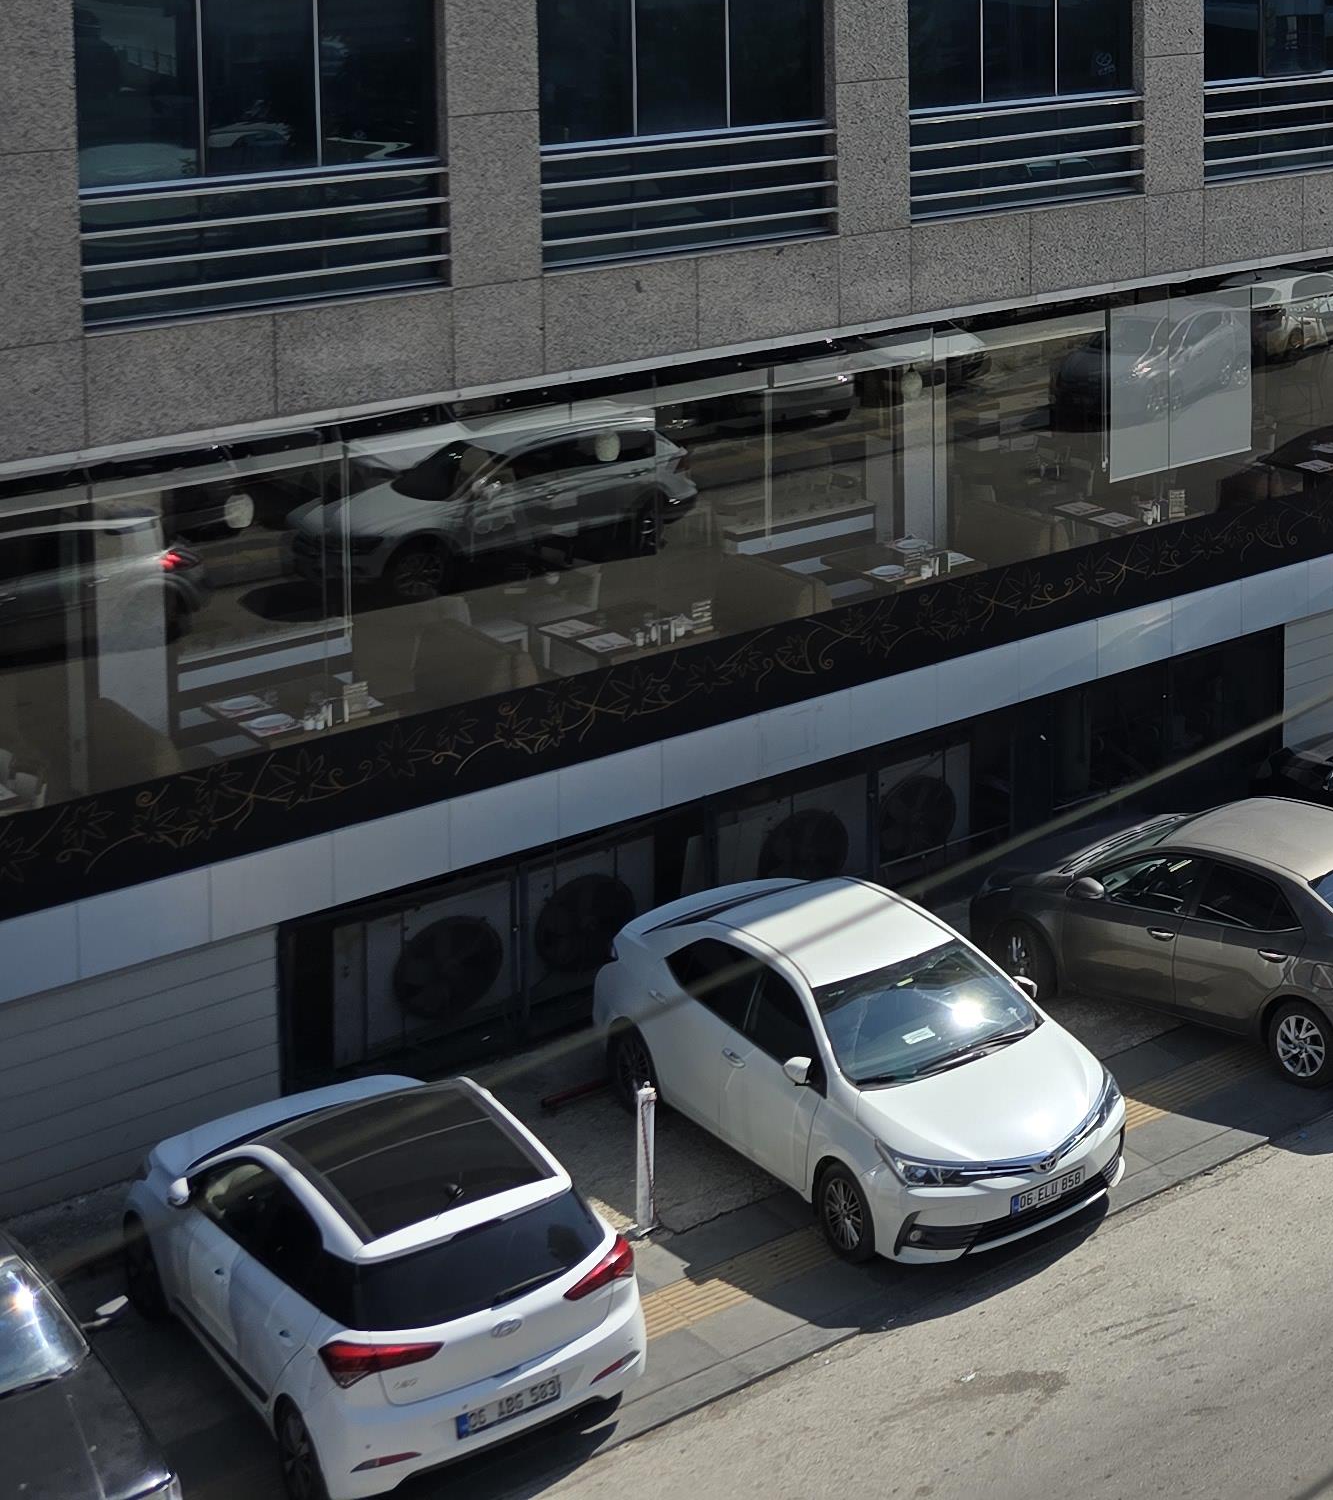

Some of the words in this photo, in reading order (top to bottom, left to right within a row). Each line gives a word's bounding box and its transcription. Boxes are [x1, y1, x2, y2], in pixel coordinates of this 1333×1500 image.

[1019, 1192, 1033, 1209] 06
[1038, 1181, 1059, 1202] ELU
[1061, 1171, 1081, 1191] 858
[468, 1408, 487, 1429] 06
[497, 1392, 525, 1418] ABG
[529, 1379, 558, 1404] 583
